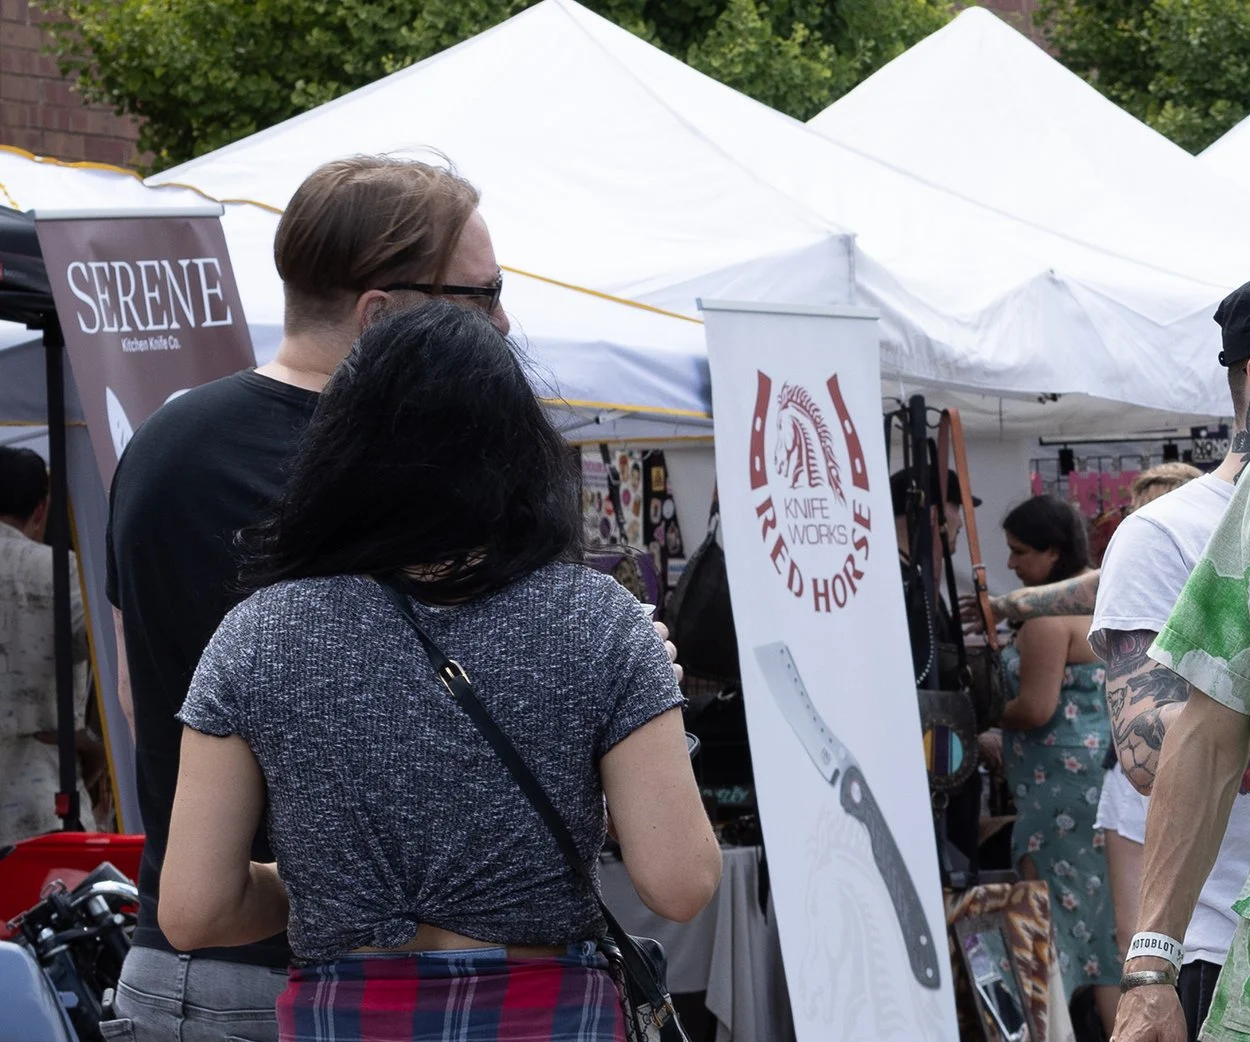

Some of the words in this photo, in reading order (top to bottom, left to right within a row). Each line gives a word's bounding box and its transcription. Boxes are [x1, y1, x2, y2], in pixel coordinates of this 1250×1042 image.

[67, 258, 233, 334] SERENE
[121, 337, 149, 352] Kitchen
[148, 336, 168, 350] Knife
[168, 335, 181, 350] Co.
[784, 498, 830, 519] KNIFE
[787, 524, 848, 545] WORKS
[755, 494, 804, 598] RED
[812, 499, 871, 613] HORSE
